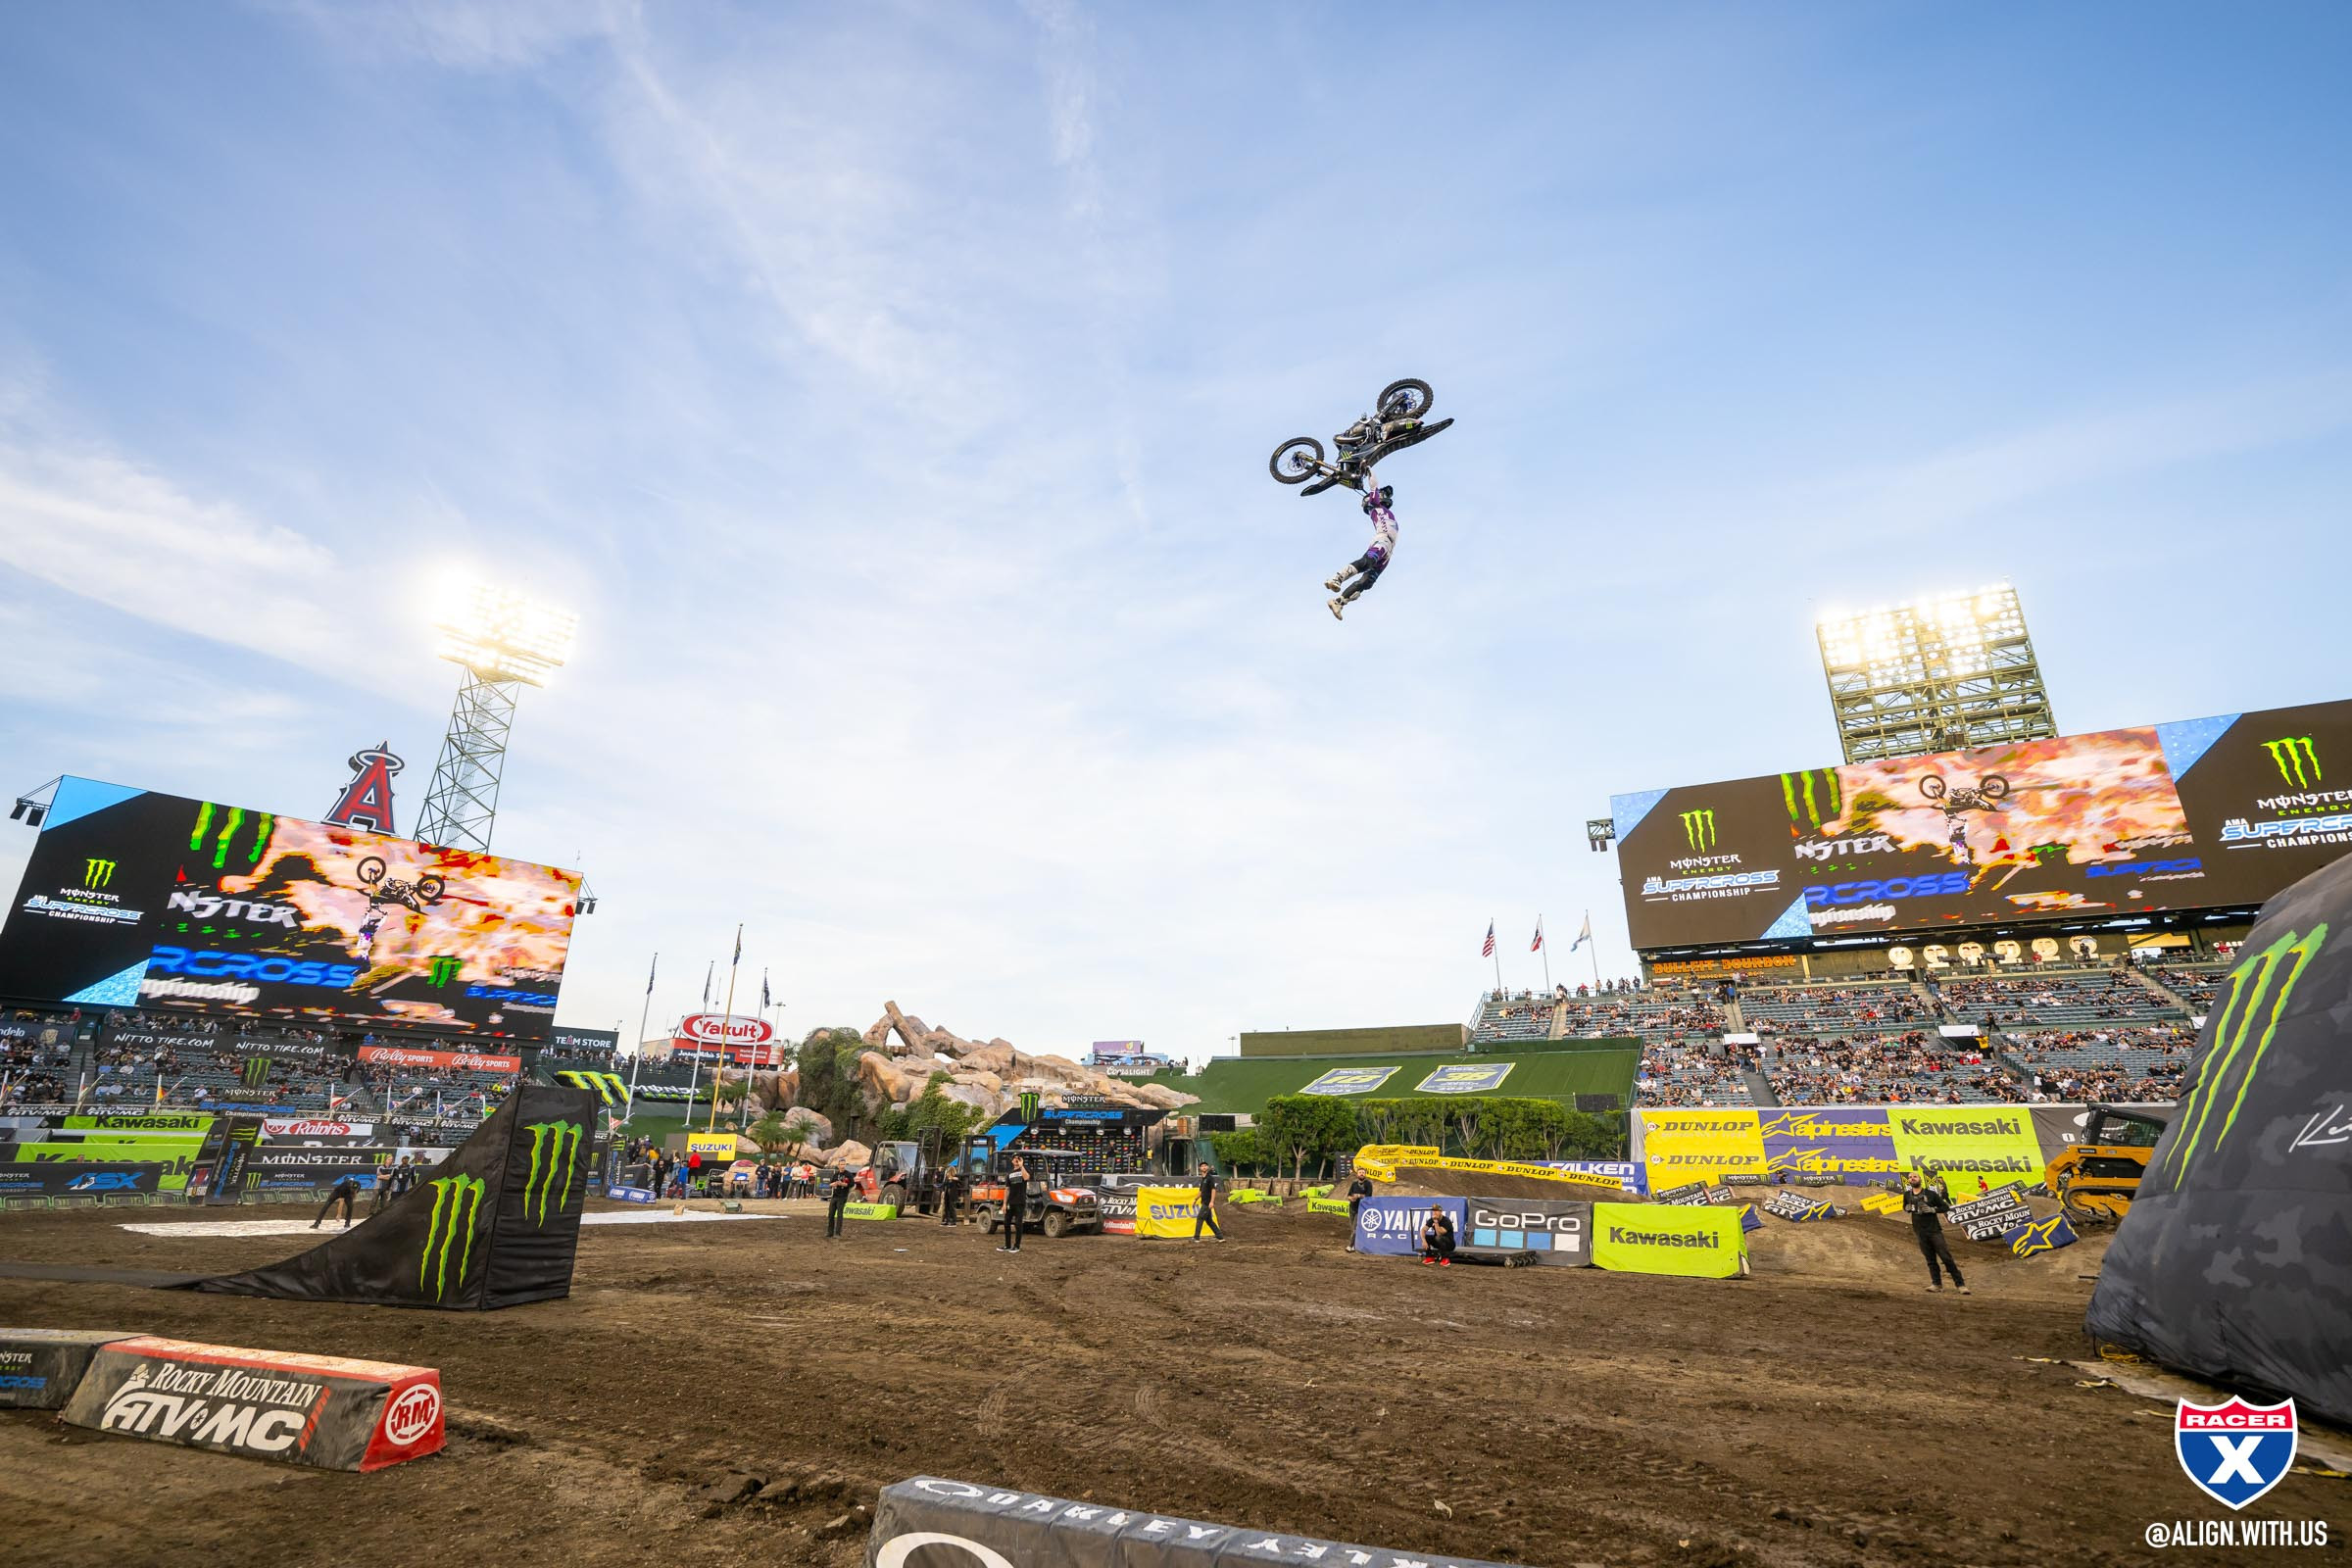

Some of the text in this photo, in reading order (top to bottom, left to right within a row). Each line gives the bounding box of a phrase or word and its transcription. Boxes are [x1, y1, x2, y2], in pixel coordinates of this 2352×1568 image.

[321, 740, 404, 838] A
[2256, 790, 2352, 809] MONSTE
[2278, 804, 2352, 816] ENERGY
[2225, 817, 2248, 827] AMA
[1669, 854, 1742, 870] MONSTER
[1682, 865, 1733, 875] ENERGY
[1642, 870, 1780, 895] SUPERCROSS
[60, 888, 120, 903] MONSTER
[67, 896, 110, 906] ENERGY
[1671, 887, 1752, 902] CHAMPIONSHIP
[25, 899, 143, 920] SUPERCROSS
[48, 910, 117, 923] CHAMPIONSHIP
[114, 1033, 216, 1049] NITTO TIRE.COM
[235, 1041, 325, 1054] NITTO TIRE.COM
[555, 1035, 612, 1048] TEAM STORE
[369, 1048, 434, 1065] Bally SPORTS
[485, 1059, 511, 1068] SPORTS
[224, 1088, 276, 1097] MONSTER
[1062, 1095, 1106, 1103] MONSTER
[199, 1102, 297, 1113] SUPERCROSS
[1042, 1110, 1124, 1119] SUPERCROSS
[95, 1115, 201, 1130] Kawasaki
[295, 1121, 345, 1136] Ralphs
[1663, 1121, 1754, 1132] DUNLOP
[1901, 1118, 2021, 1136] Kawasaki
[1795, 1120, 1891, 1141] alpinestars
[690, 1143, 733, 1153] SUZUKI
[262, 1152, 363, 1164] MONSTER
[1449, 1160, 1494, 1169] DUNLOP
[1667, 1154, 1760, 1165] DUNLOP
[1910, 1154, 2033, 1174] Kawasaki
[1506, 1165, 1555, 1177] DUNLOP
[1802, 1156, 1900, 1176] alpinestars
[1568, 1173, 1620, 1186] DUNLOP
[1671, 1191, 1705, 1205] MOUNTAIN
[1955, 1194, 2011, 1214] ROCKY MOUNTAIN
[844, 1206, 876, 1216] awasaki
[1311, 1202, 1349, 1213] Kawasaki
[1475, 1209, 1581, 1232] GoPro
[1978, 1217, 2003, 1228] ROCKY
[1609, 1226, 1720, 1250] Kawasaki
[148, 1362, 321, 1408] ROCKY MOUNTAIN
